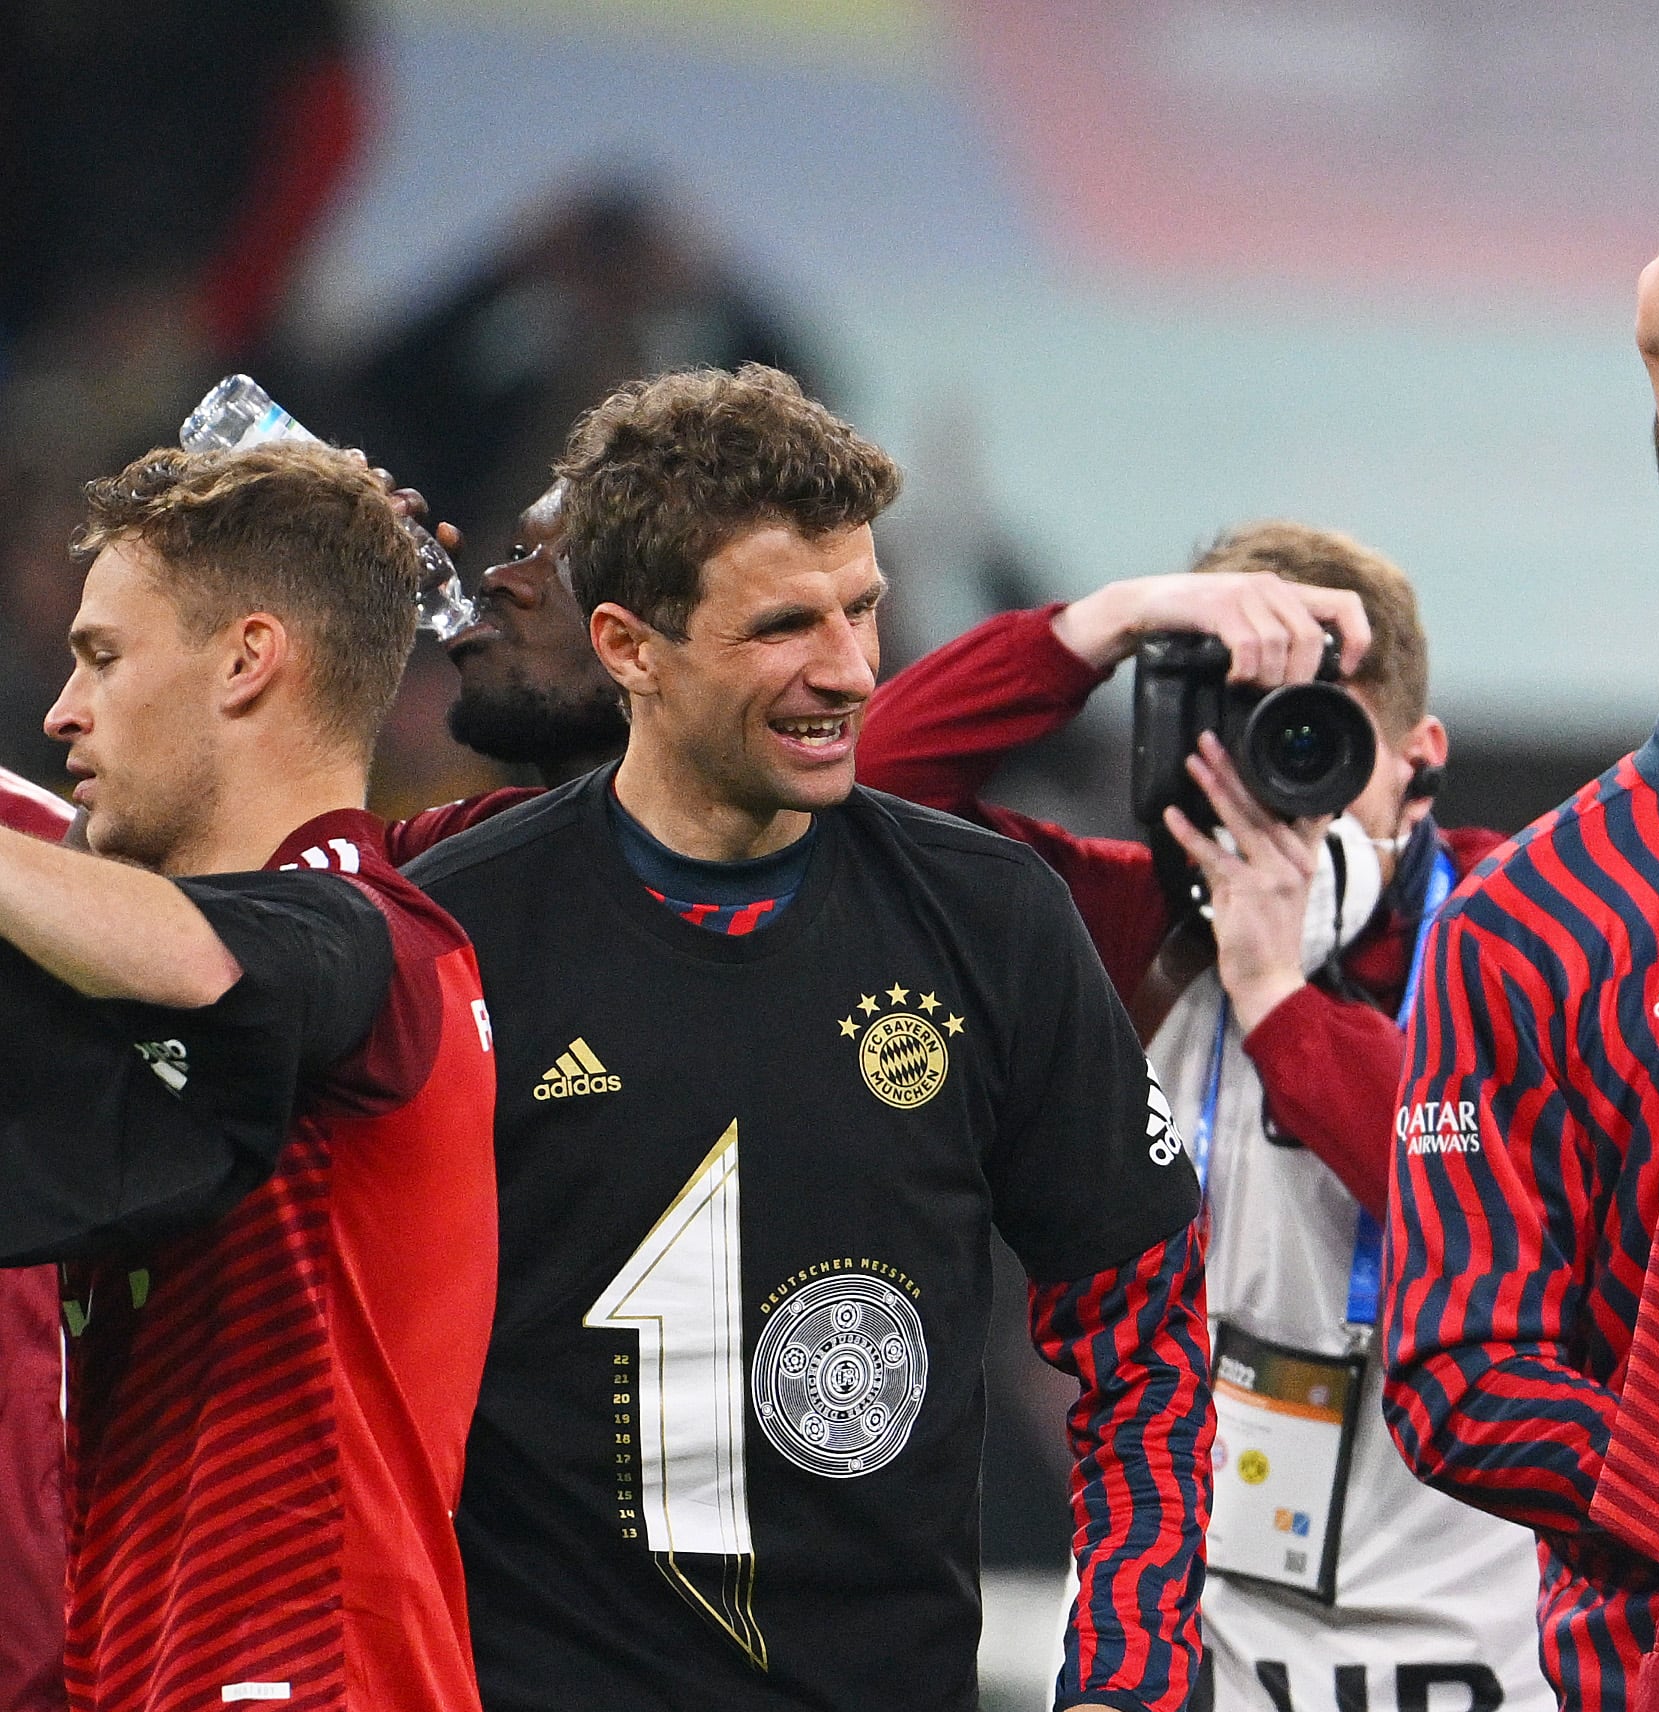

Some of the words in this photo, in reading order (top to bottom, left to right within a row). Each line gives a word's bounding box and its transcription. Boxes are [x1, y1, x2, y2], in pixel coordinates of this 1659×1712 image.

[867, 1034, 883, 1055] FC
[882, 1020, 939, 1053] BAYERN
[533, 1073, 622, 1100] adidas
[870, 1069, 940, 1101] MÜNCHEN
[1396, 1101, 1478, 1141] QATAR
[1408, 1133, 1480, 1156] AIRWAYS
[760, 1258, 853, 1314] DEUTSCHER
[860, 1258, 922, 1299] MEISTER
[613, 1355, 630, 1365] 22
[613, 1374, 629, 1384] 21
[613, 1393, 631, 1404] 20
[614, 1414, 631, 1424] 19
[615, 1434, 631, 1443] 18
[615, 1454, 631, 1463] 17
[617, 1491, 633, 1500] 15
[619, 1509, 636, 1519] 14
[622, 1528, 638, 1538] 13
